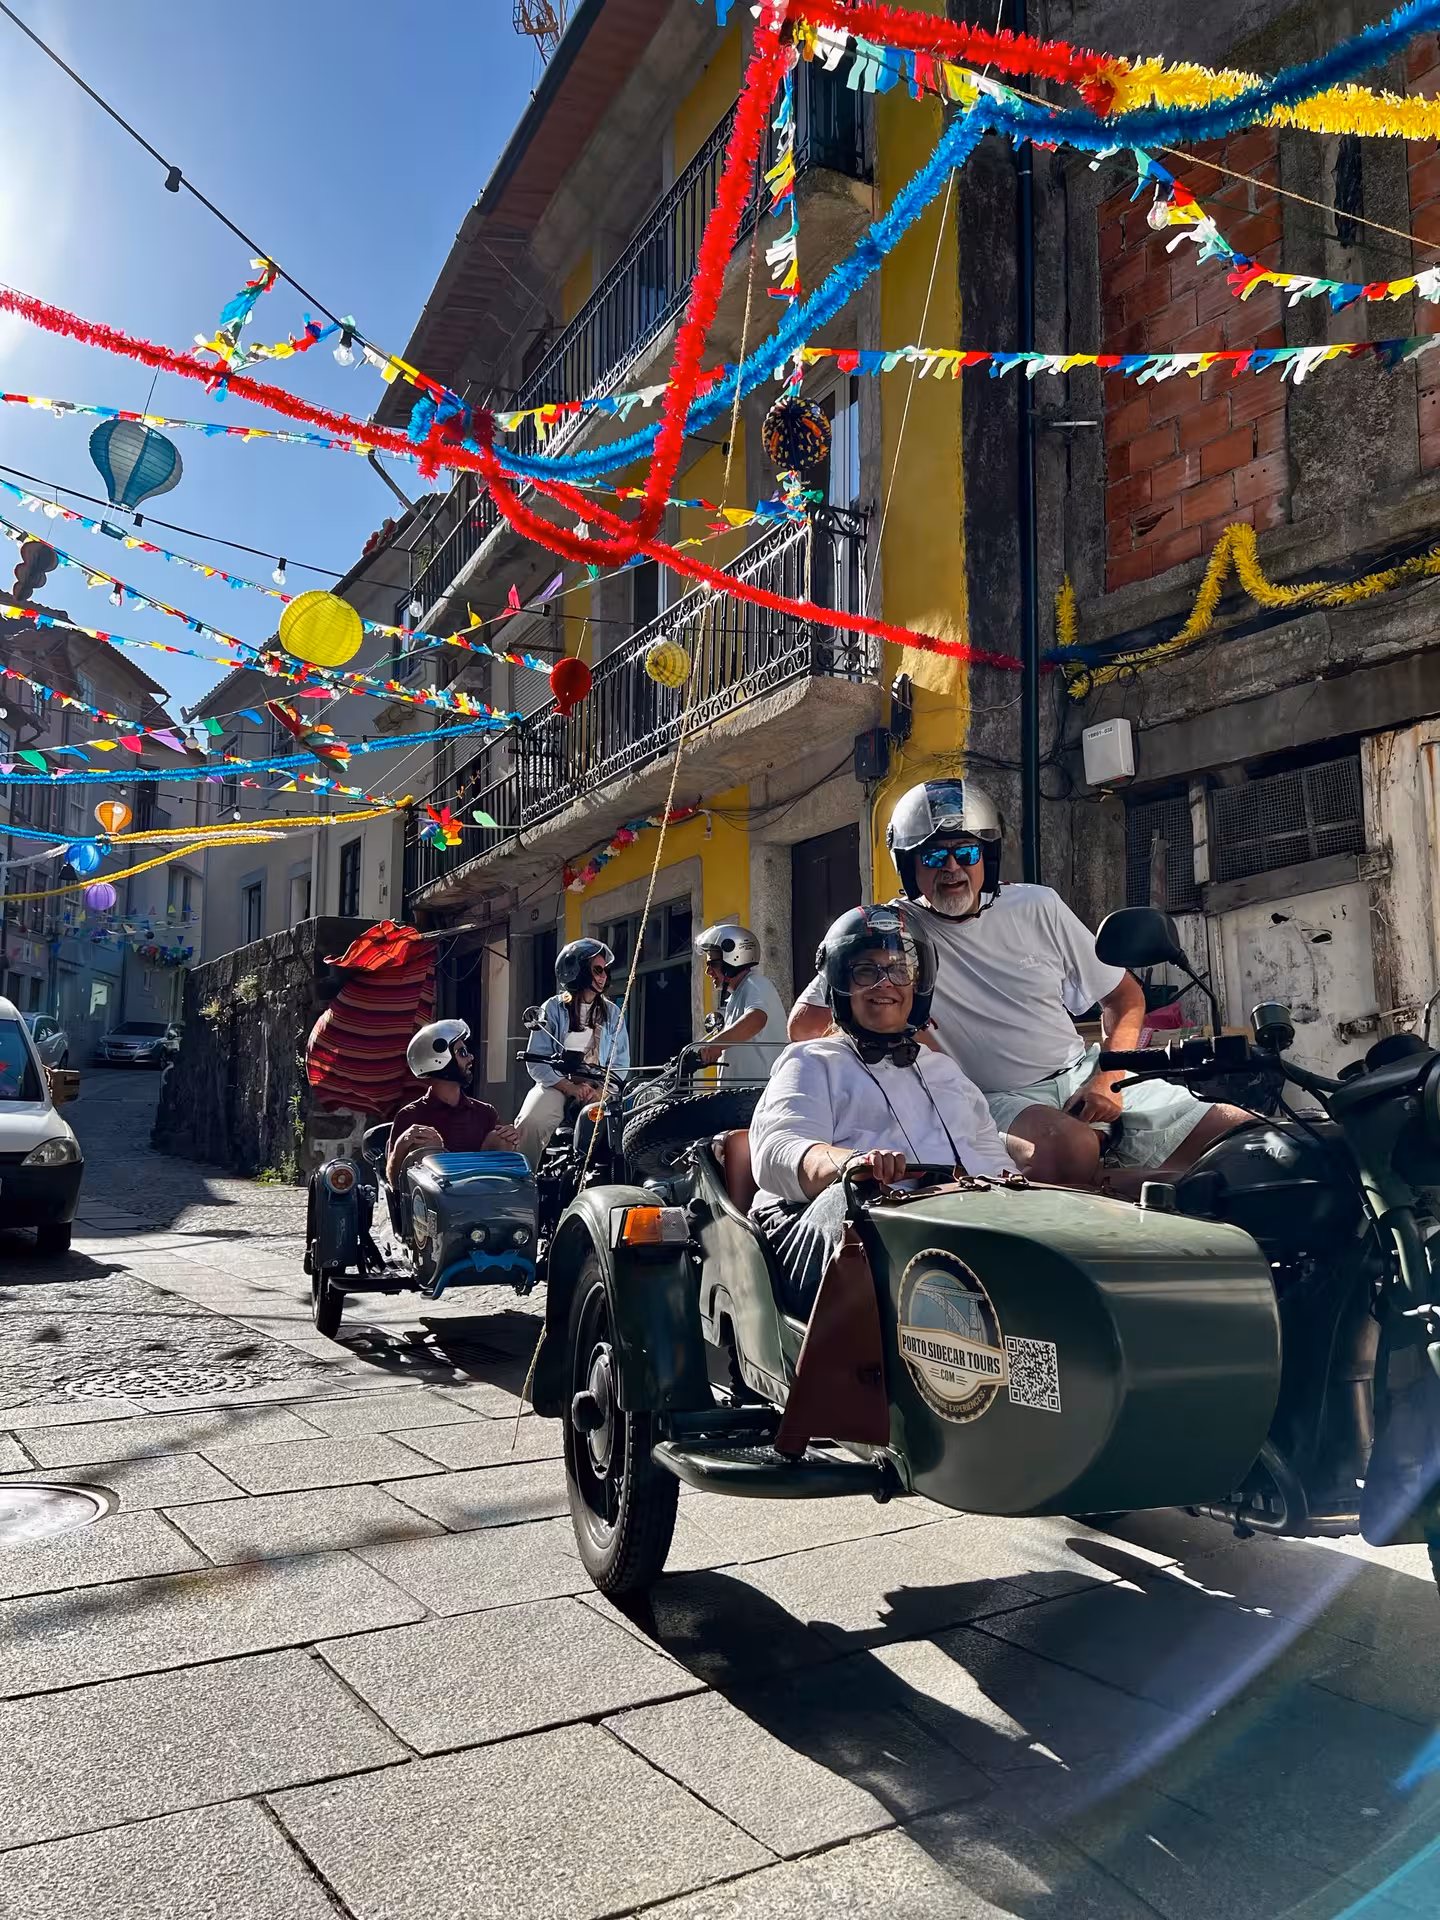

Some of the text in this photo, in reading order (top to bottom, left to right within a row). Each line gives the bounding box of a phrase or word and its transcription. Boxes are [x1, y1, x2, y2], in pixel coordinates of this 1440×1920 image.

[902, 1334, 1001, 1374] PORTO SIDECAR TOURS
